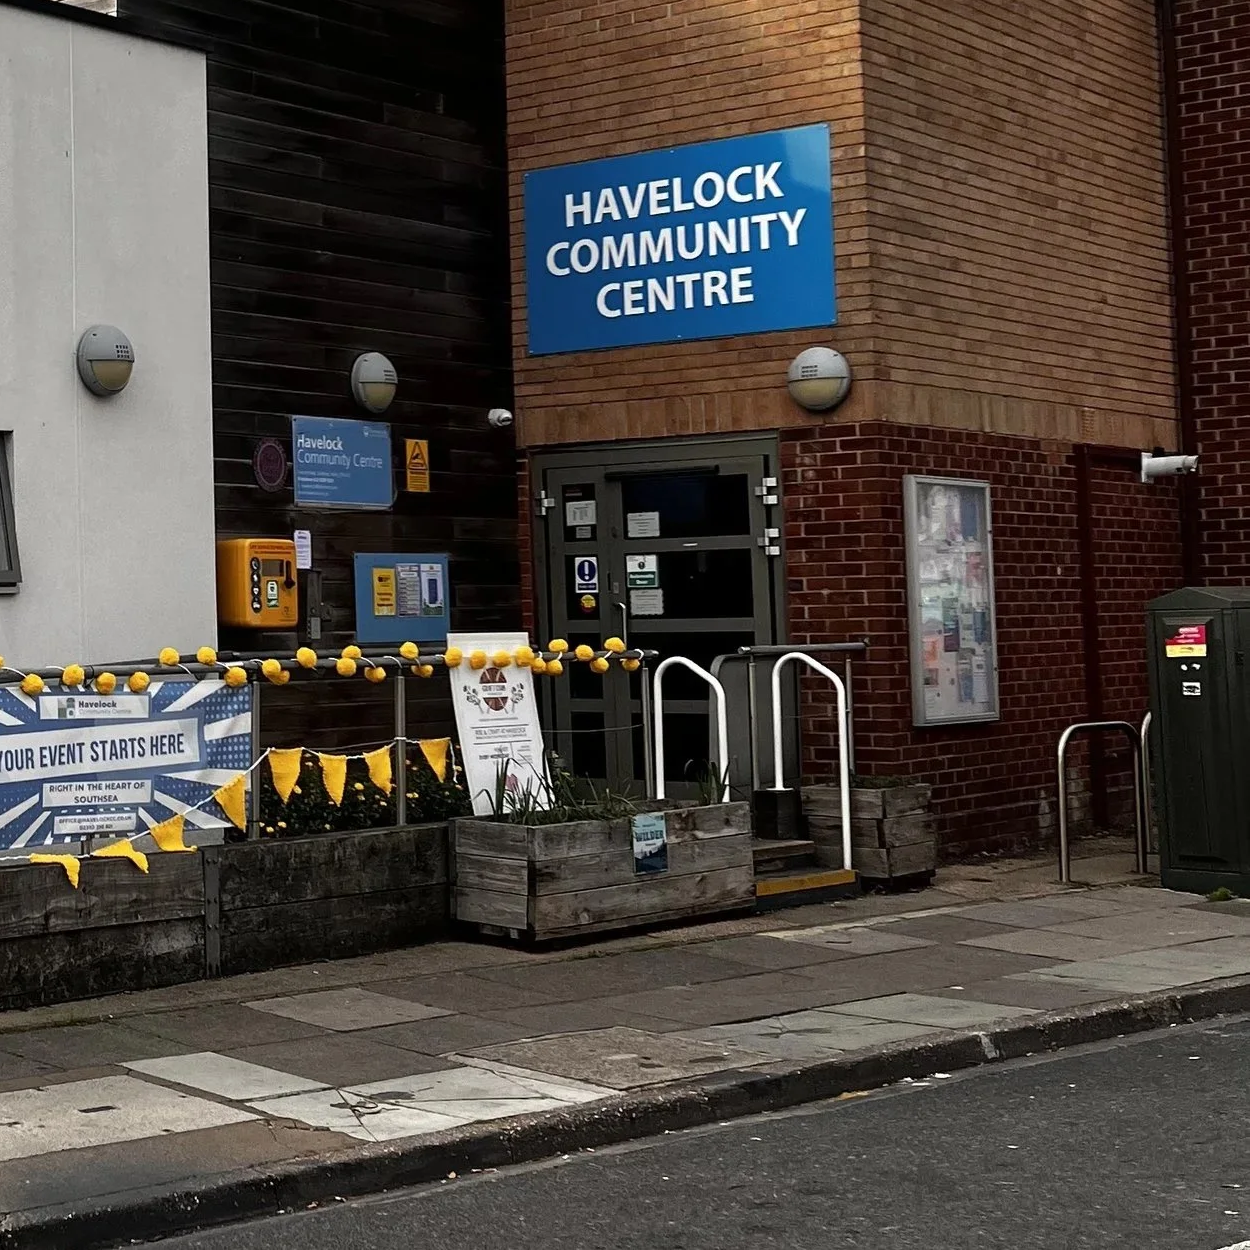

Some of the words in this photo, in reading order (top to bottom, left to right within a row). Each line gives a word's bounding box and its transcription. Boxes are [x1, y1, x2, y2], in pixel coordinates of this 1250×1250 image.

[565, 161, 784, 227] HAVELOCK
[546, 208, 807, 276] COMMUNITY
[596, 266, 754, 318] CENTRE
[297, 434, 344, 450] Havelock
[297, 450, 351, 470] Community
[353, 453, 383, 468] Centre
[78, 700, 117, 708] Havelock
[39, 742, 85, 768] EVENT
[90, 736, 146, 762] STARTS
[150, 733, 185, 757] HERE
[49, 783, 73, 793] RIGHT
[75, 782, 85, 791] IN
[87, 782, 103, 791] THE
[105, 781, 132, 790] HEART
[133, 781, 145, 789] OF
[74, 795, 118, 804] SOUTHSEA
